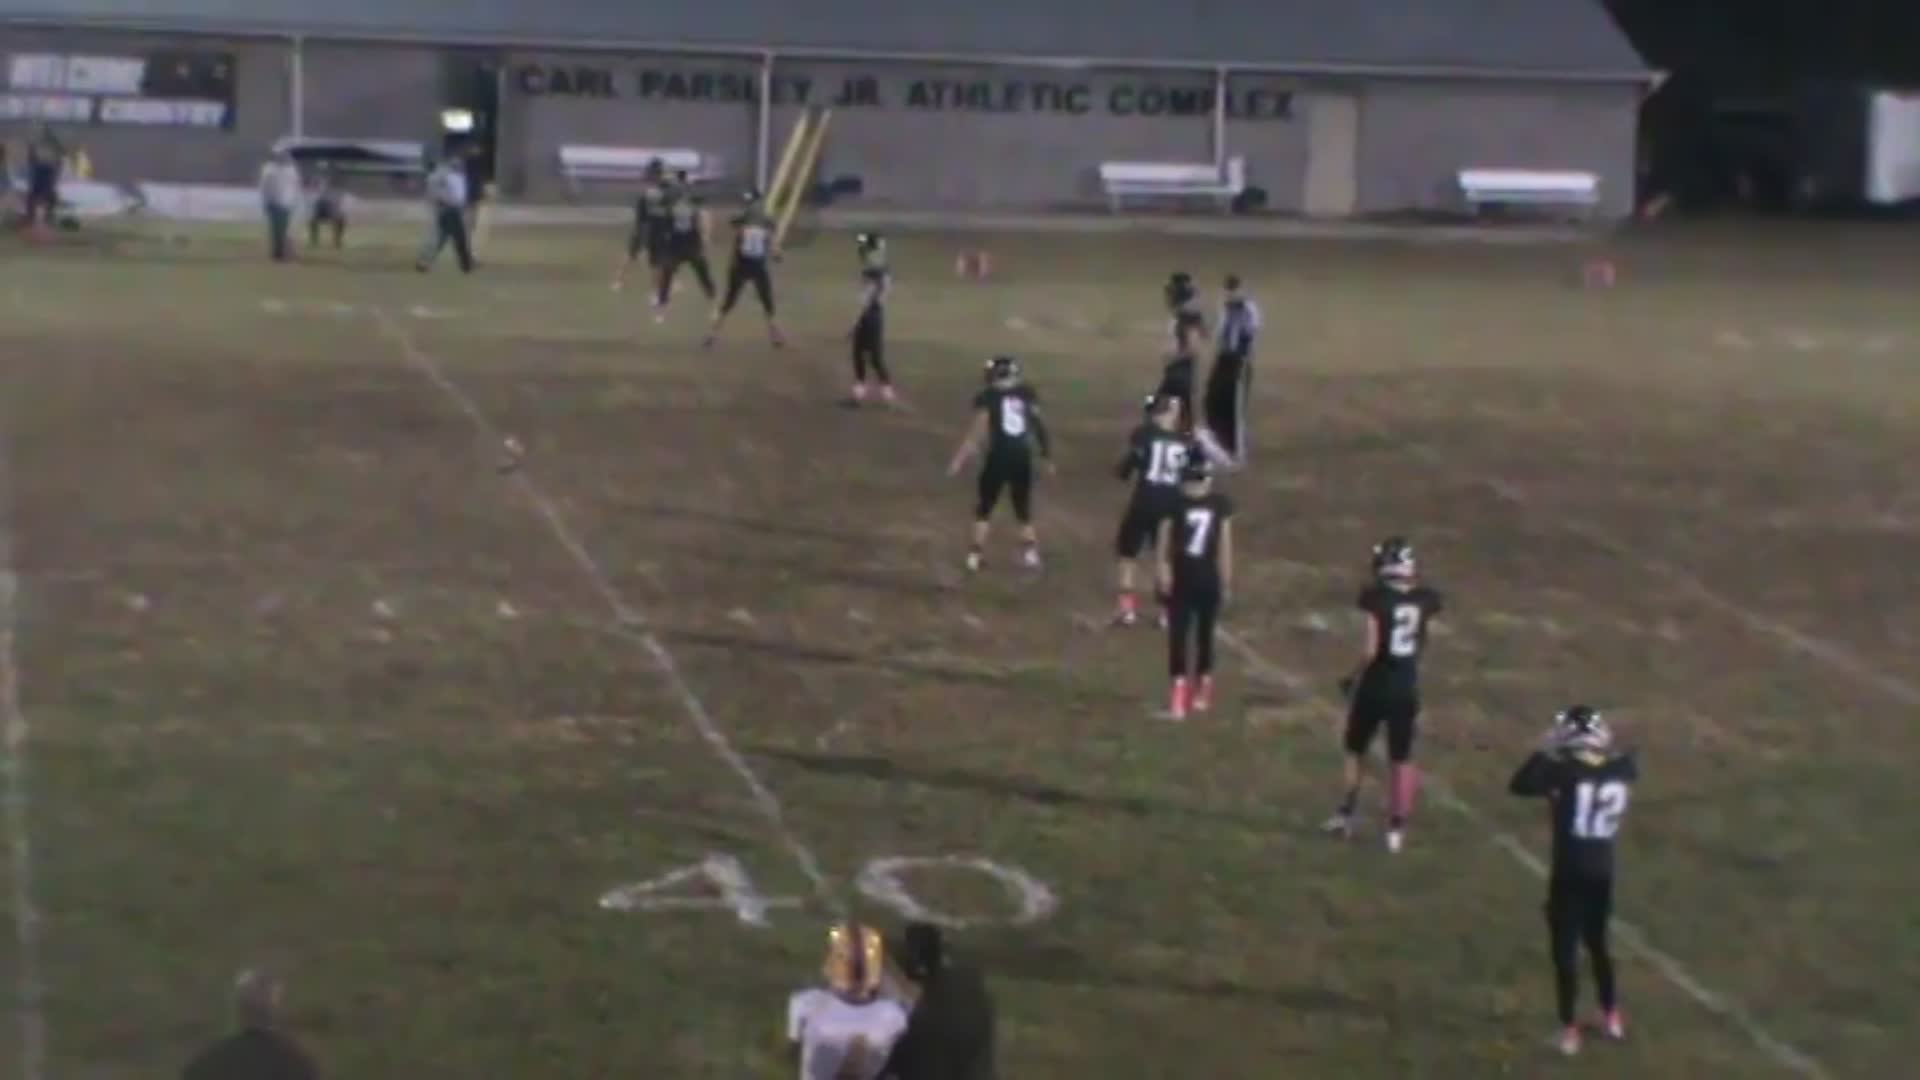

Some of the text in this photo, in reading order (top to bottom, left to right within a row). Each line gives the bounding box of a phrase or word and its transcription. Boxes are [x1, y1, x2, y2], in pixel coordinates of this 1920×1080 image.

[518, 66, 618, 98] CARL
[639, 69, 814, 104] PARSLEY
[907, 79, 1091, 115] ATHLETIC
[1108, 85, 1295, 120] COMPLEX
[1185, 508, 1214, 558] 7
[1389, 604, 1421, 657] 2
[1572, 781, 1627, 839] 12
[599, 852, 1057, 929] 40
